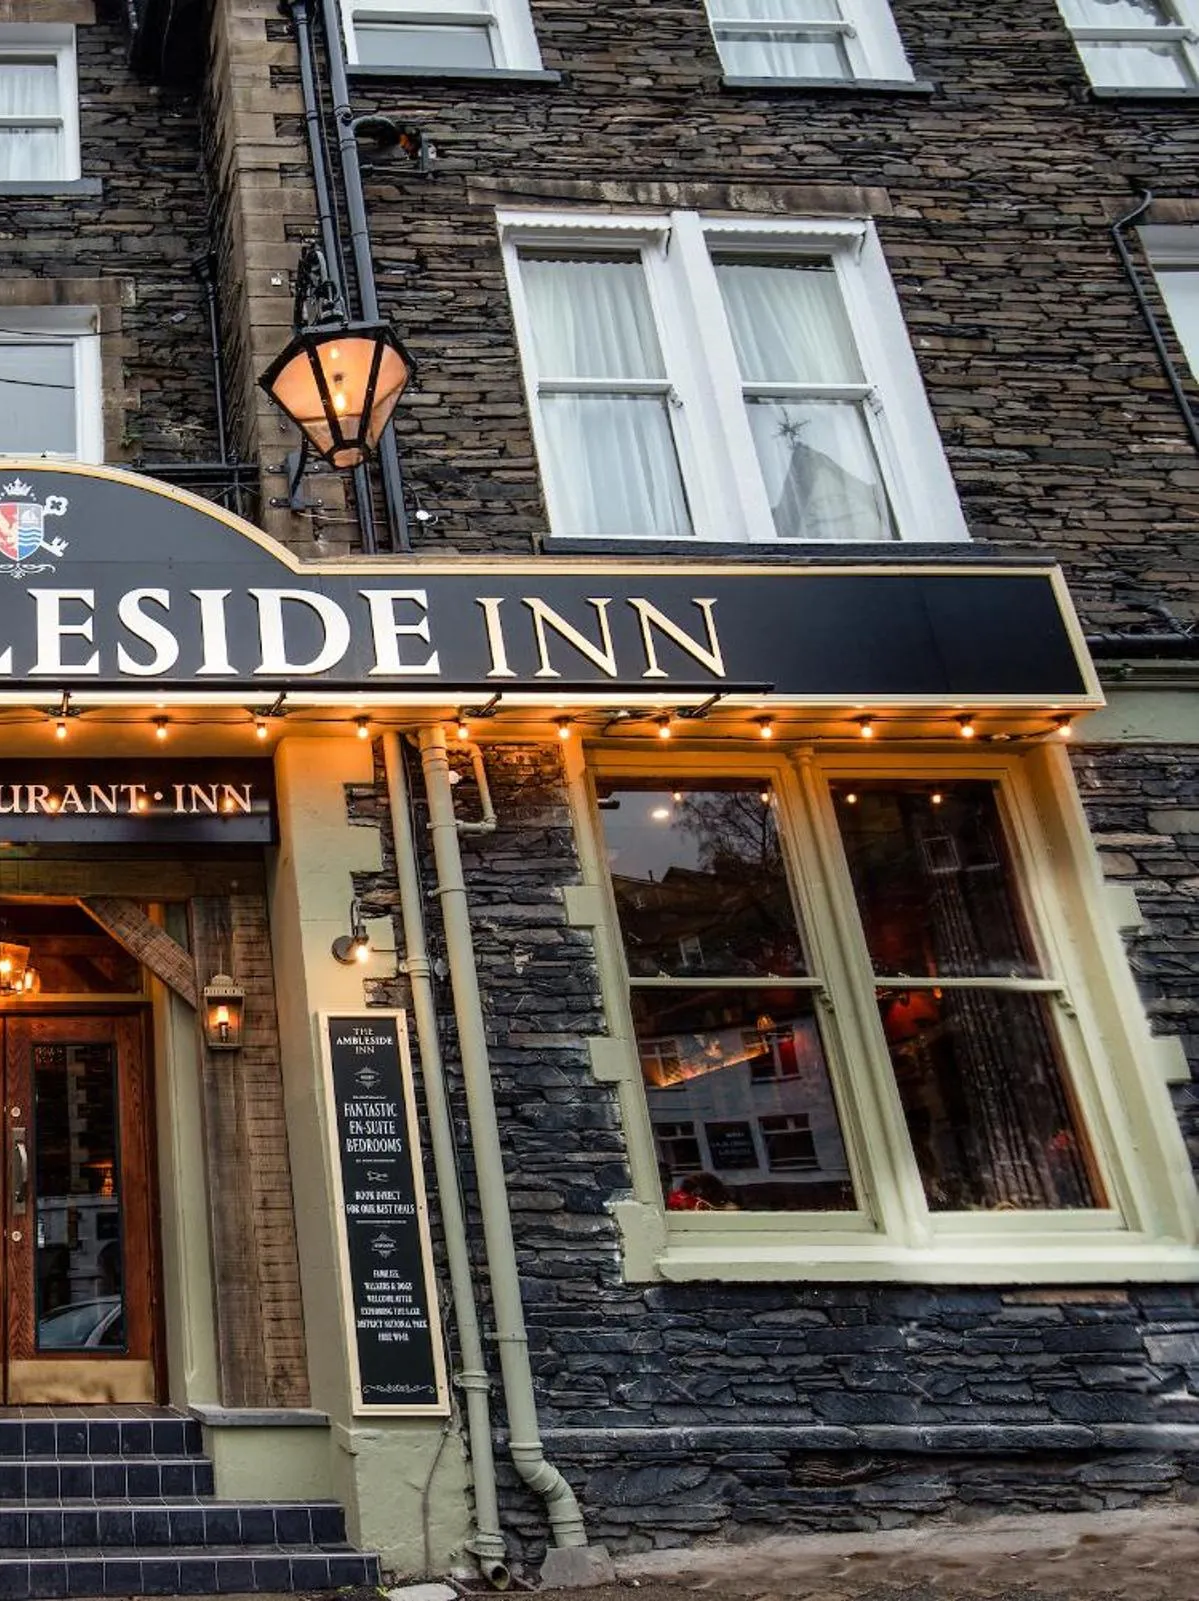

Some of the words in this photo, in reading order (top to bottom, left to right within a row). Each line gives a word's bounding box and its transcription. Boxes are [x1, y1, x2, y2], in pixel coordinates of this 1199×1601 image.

[475, 596, 727, 679] INN
[173, 784, 253, 814] INN
[352, 1027, 375, 1036] THE
[336, 1036, 394, 1046] AMBLESIDE
[355, 1045, 376, 1055] INN
[343, 1102, 399, 1118] FANTASTIC
[349, 1120, 397, 1135] EN-SUITE
[345, 1138, 403, 1153] BEDROOMS
[345, 1203, 360, 1215] FOR
